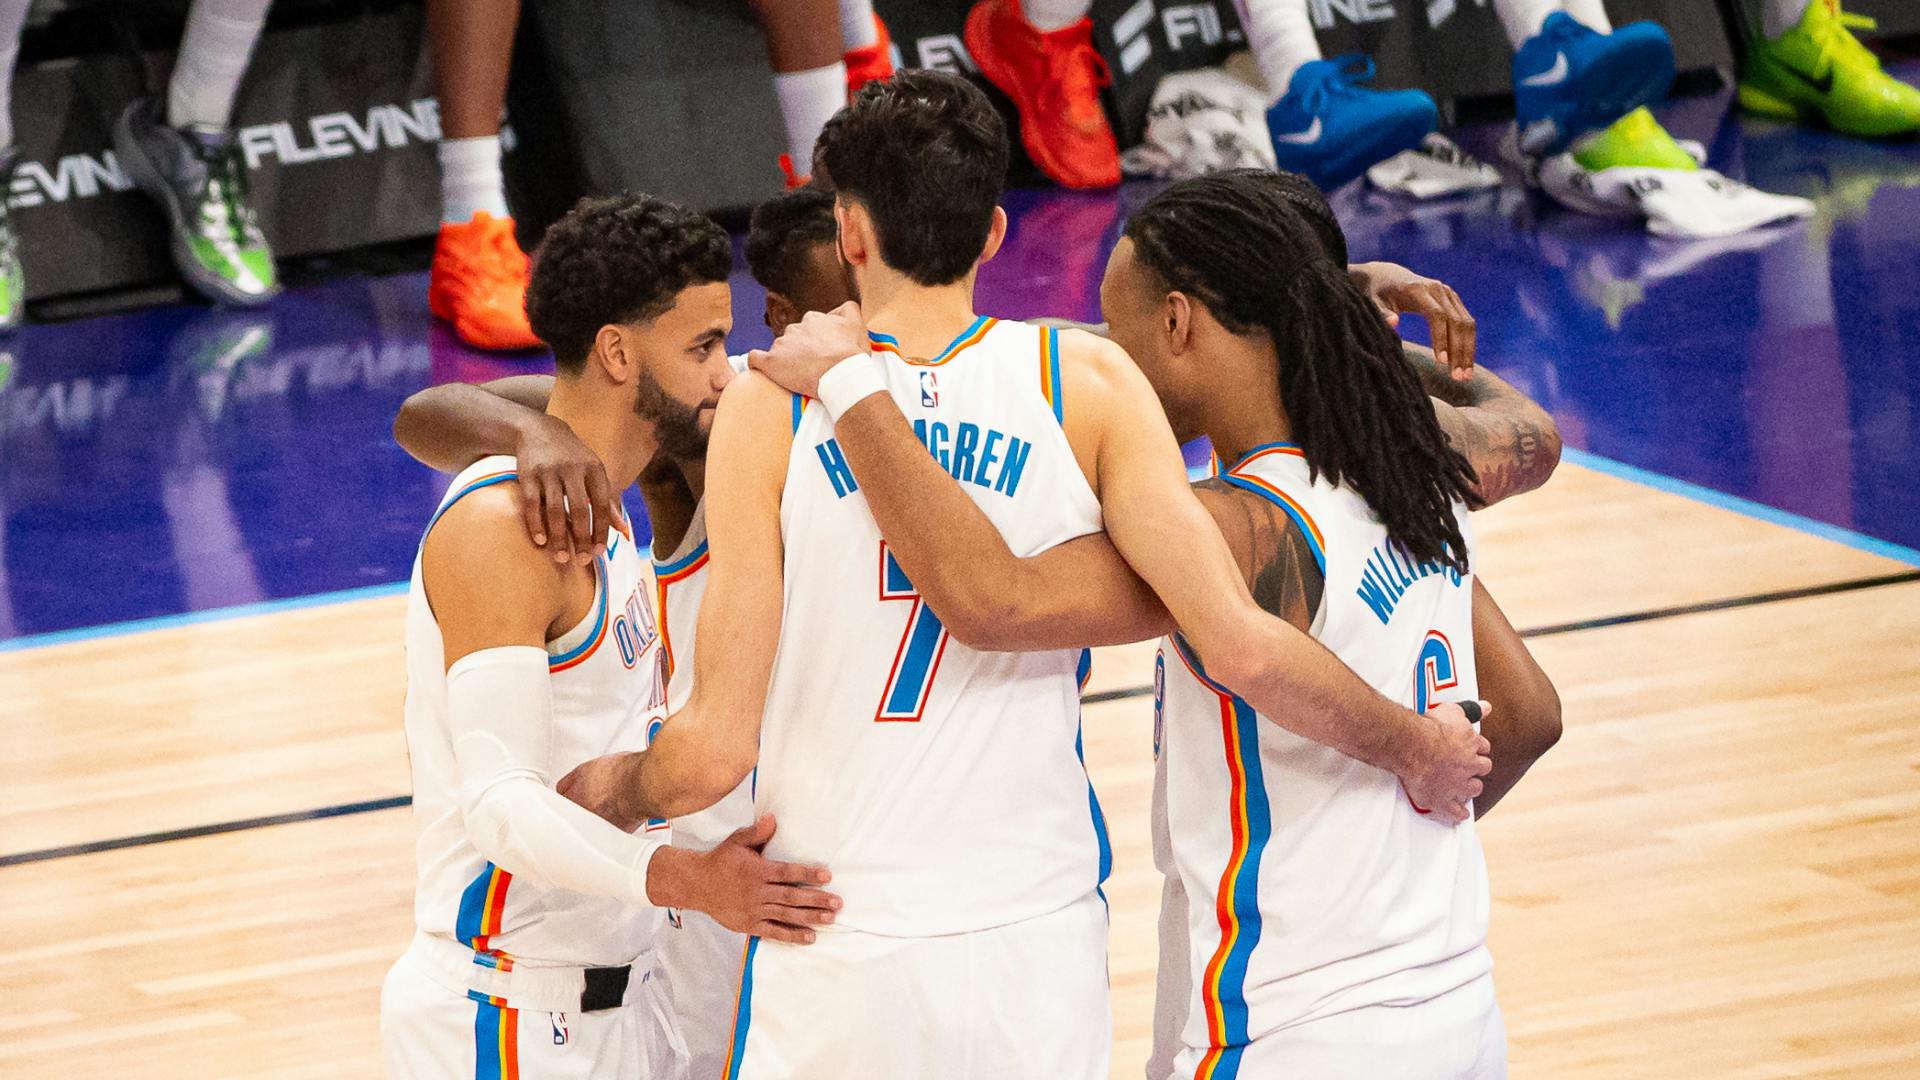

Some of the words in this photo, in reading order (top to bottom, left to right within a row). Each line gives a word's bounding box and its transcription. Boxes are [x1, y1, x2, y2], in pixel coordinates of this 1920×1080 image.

[239, 97, 442, 170] FILEVIN
[815, 418, 1032, 499] HGREN
[874, 539, 950, 722] 7
